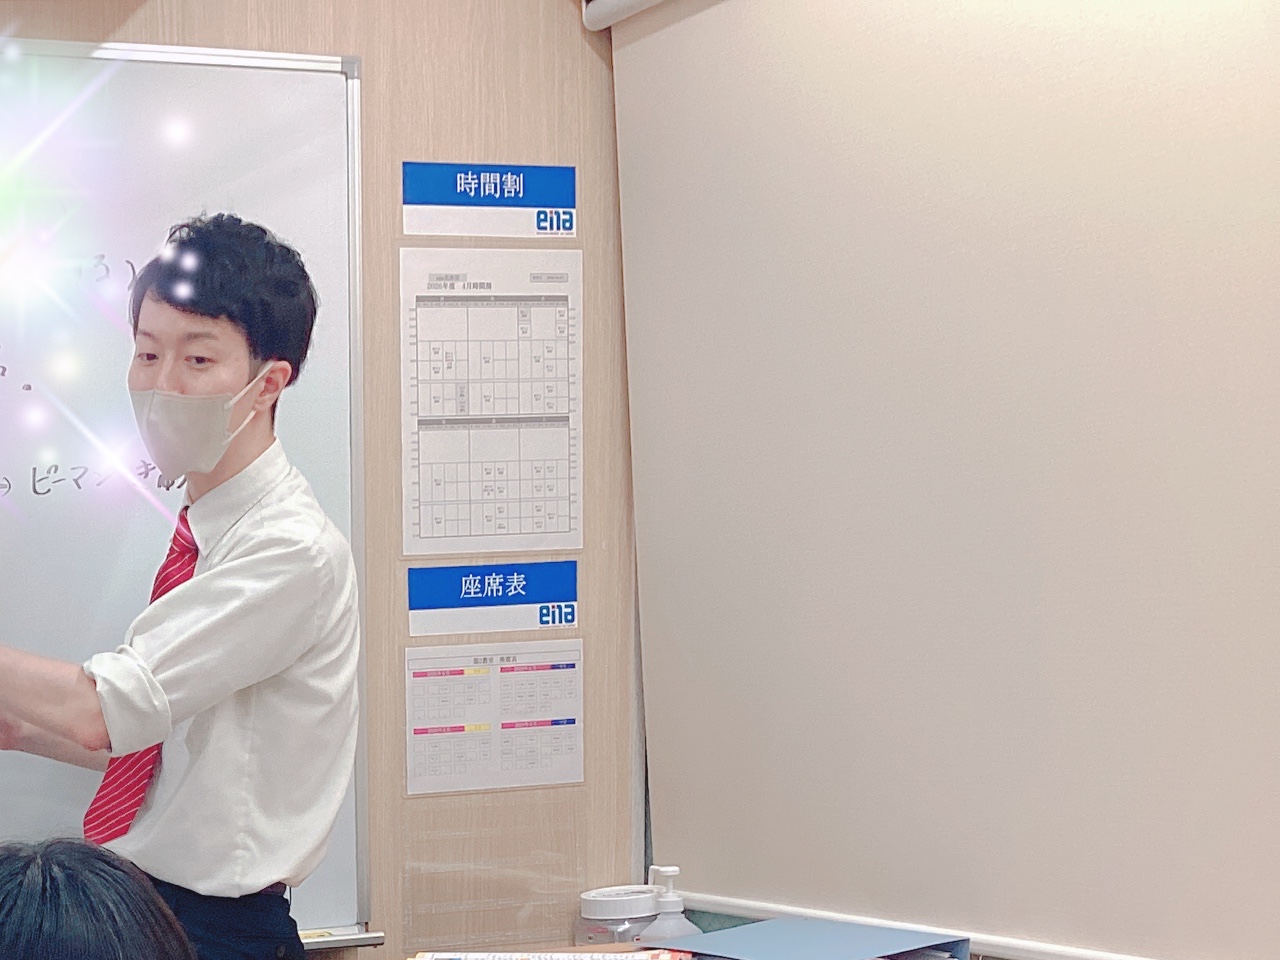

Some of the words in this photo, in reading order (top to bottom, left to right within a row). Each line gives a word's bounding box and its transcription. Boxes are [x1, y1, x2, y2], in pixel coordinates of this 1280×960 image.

[456, 170, 524, 198] 時間割
[536, 209, 574, 231] ena
[460, 572, 526, 598] 座席表
[539, 604, 575, 625] ena
